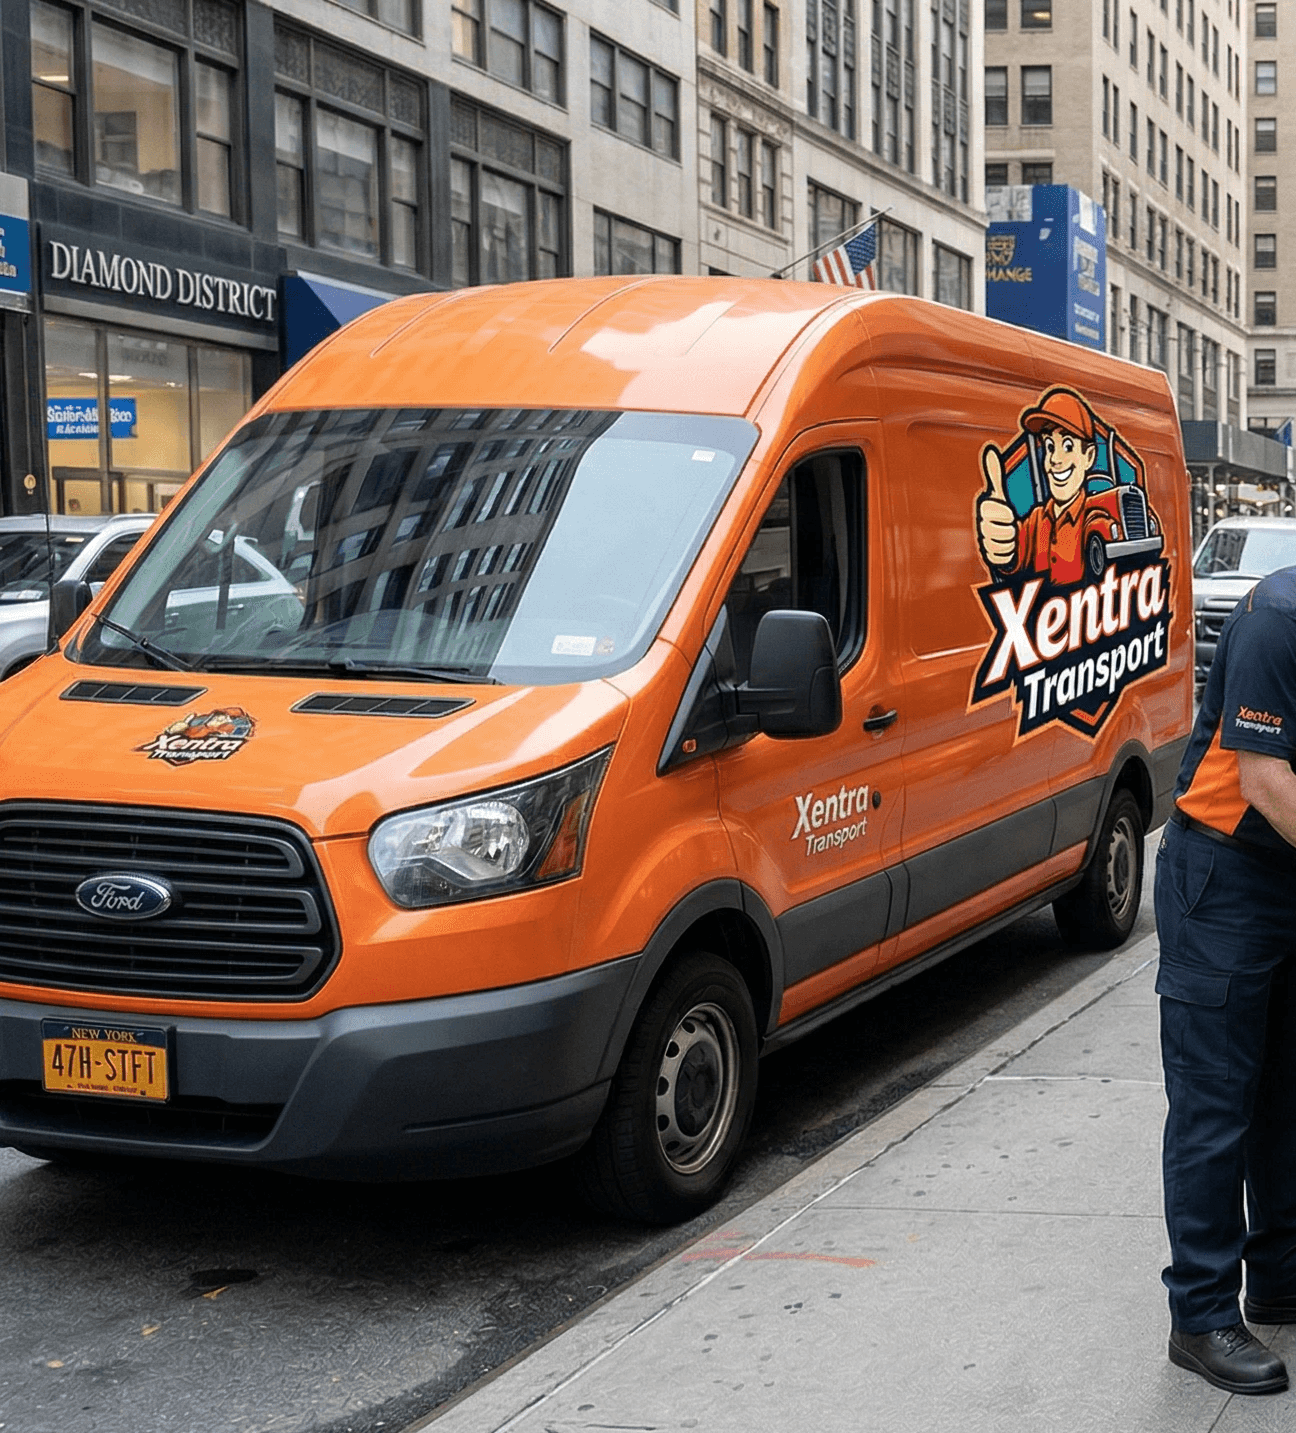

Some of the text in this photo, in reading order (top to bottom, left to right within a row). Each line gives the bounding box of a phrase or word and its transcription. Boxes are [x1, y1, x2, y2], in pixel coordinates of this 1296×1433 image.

[50, 240, 277, 322] DIAMOND DISTRICT
[982, 563, 1167, 688] Xentra
[1023, 621, 1165, 720] Transport
[790, 785, 869, 840] Xentra
[805, 816, 868, 857] Transport
[90, 881, 146, 911] Ford
[71, 1027, 137, 1043] NEW YORK
[52, 1043, 156, 1085] 47H-STFT
